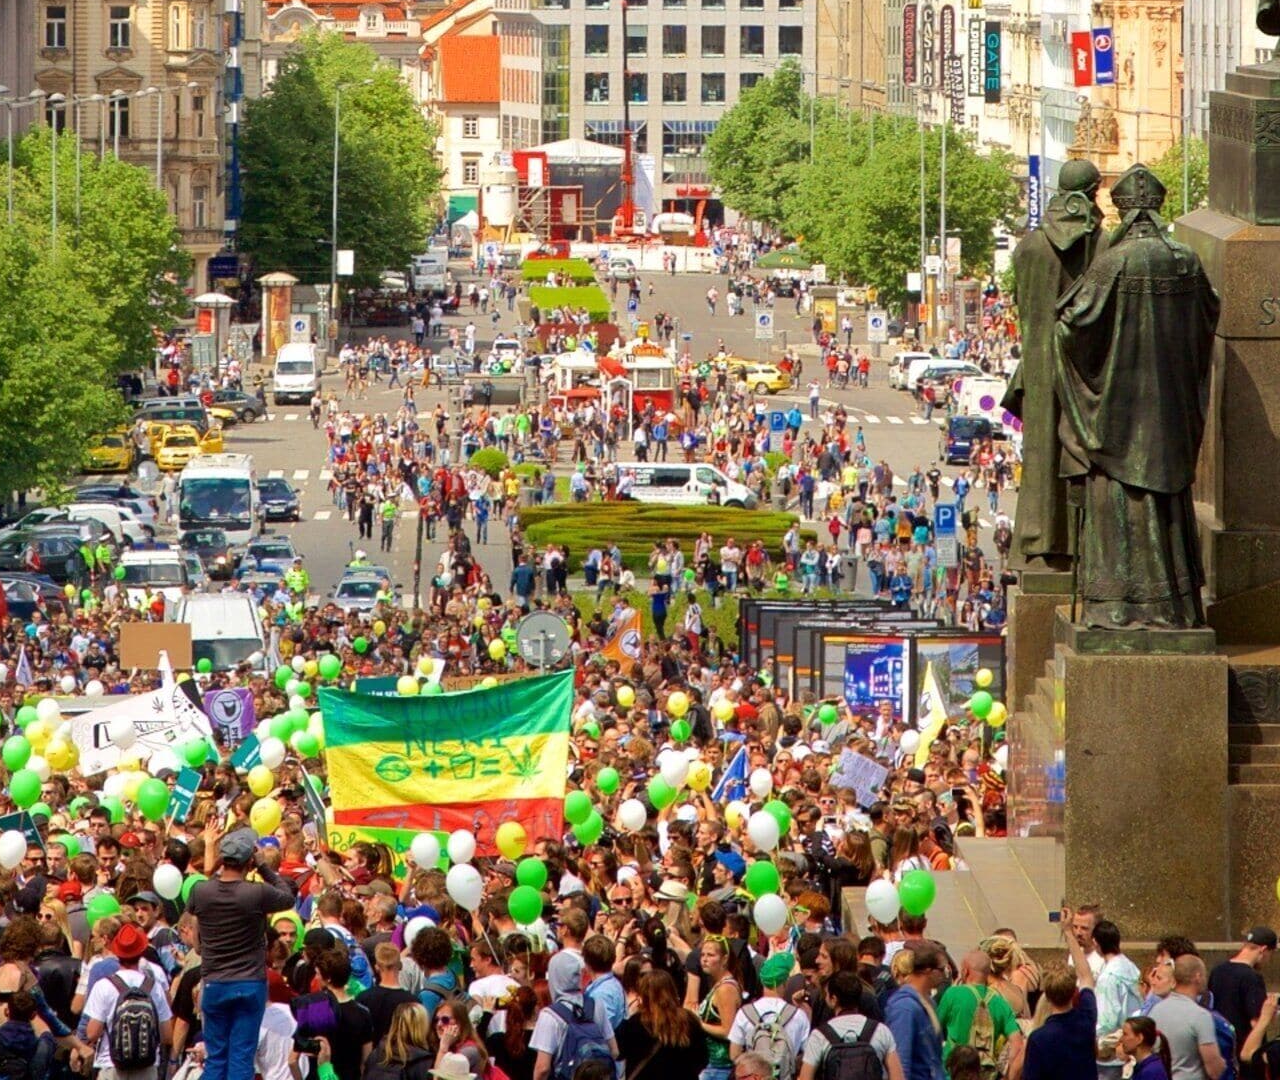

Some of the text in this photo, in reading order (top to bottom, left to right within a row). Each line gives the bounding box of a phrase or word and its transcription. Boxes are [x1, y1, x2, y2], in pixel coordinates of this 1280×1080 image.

[923, 8, 933, 87] CASINO
[987, 33, 999, 90] GATE
[1029, 176, 1038, 216] GRAAF
[773, 411, 783, 427] P
[939, 508, 952, 526] P
